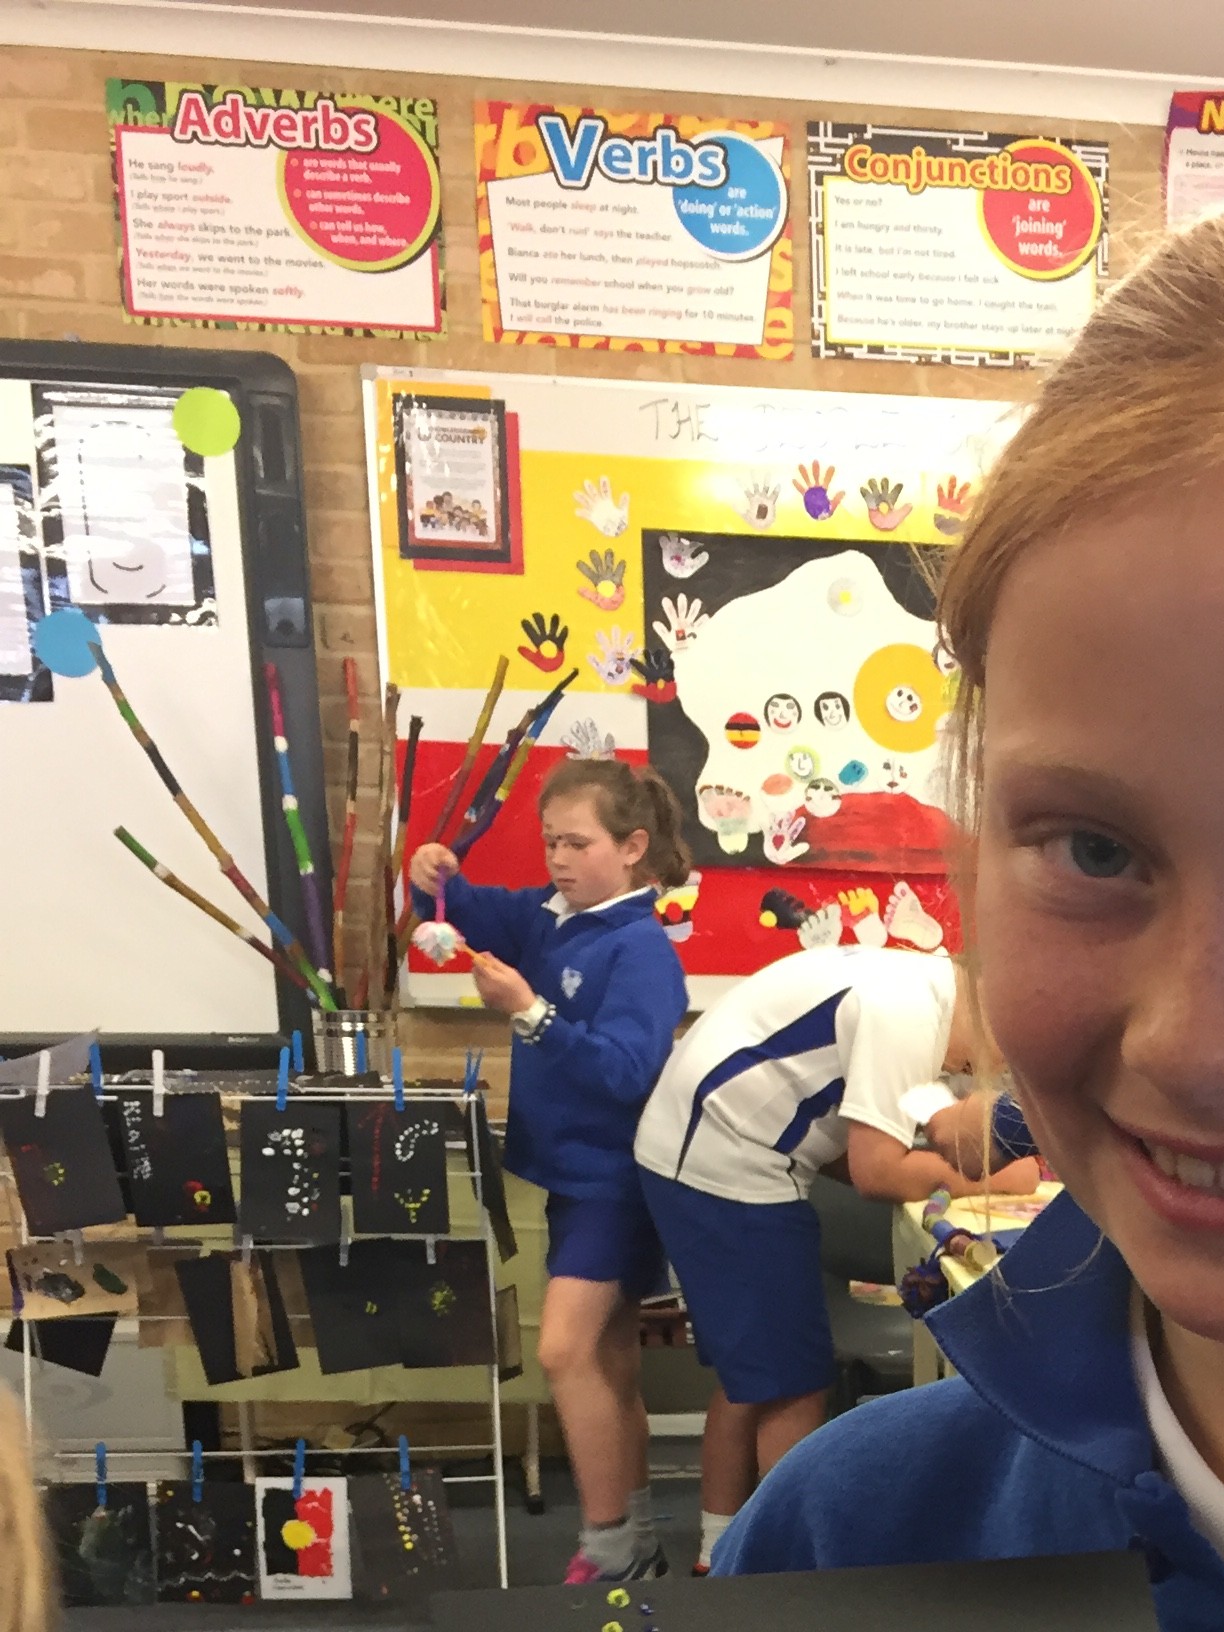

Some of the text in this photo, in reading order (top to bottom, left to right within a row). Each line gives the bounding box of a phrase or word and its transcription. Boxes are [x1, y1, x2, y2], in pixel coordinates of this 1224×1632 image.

[174, 91, 378, 151] Adverbs
[539, 114, 727, 188] Verbs
[846, 145, 1072, 193] Conjunctions
[727, 186, 747, 200] are
[719, 204, 732, 217] or
[1027, 198, 1051, 213] are
[709, 220, 750, 236] words.
[1018, 240, 1063, 258] words.
[639, 398, 718, 442] THE
[435, 433, 484, 444] COUNTRY
